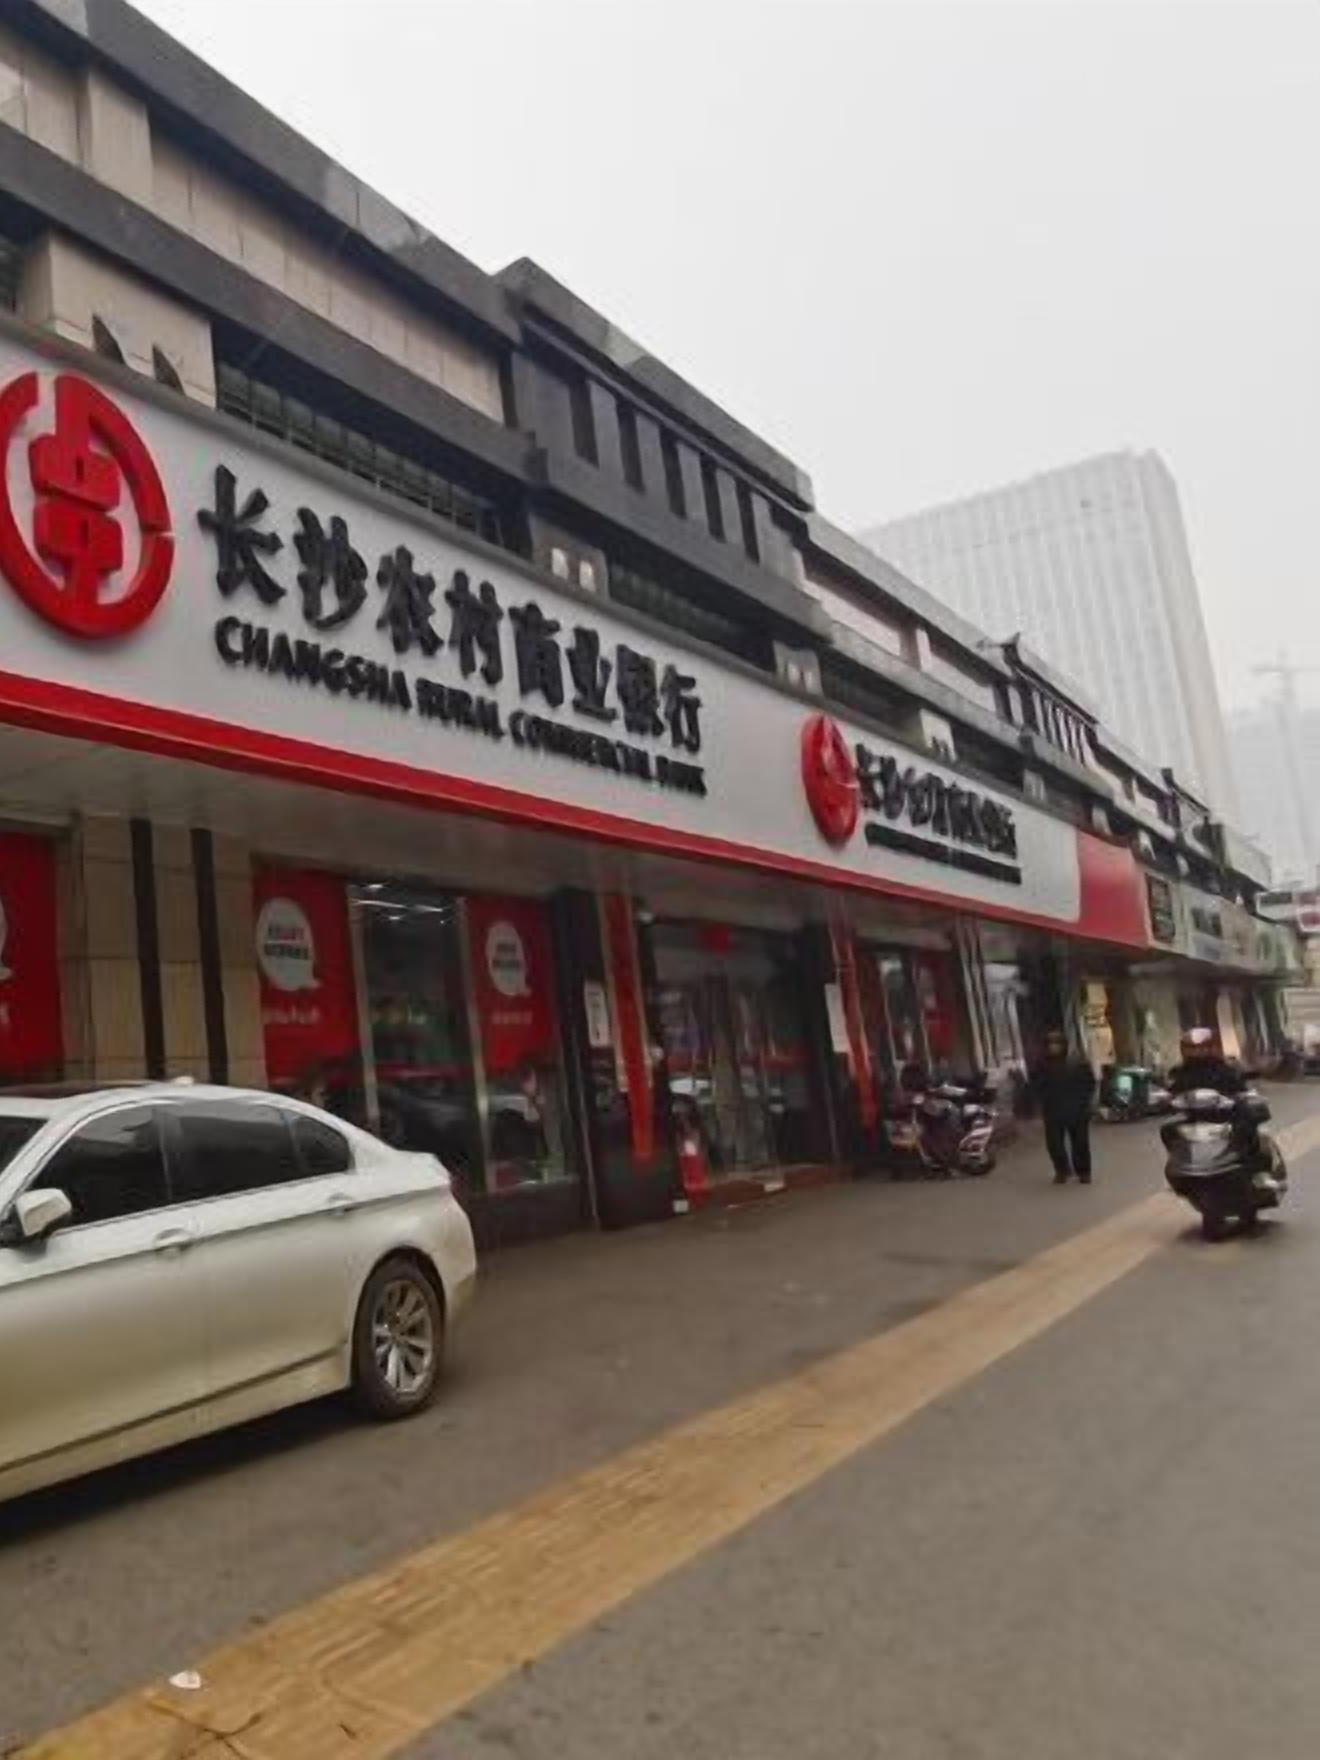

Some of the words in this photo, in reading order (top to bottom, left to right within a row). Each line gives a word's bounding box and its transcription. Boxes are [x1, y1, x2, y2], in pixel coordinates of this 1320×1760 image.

[198, 464, 702, 753] 长沙农村商业银行
[215, 616, 412, 709] CHANGSHA
